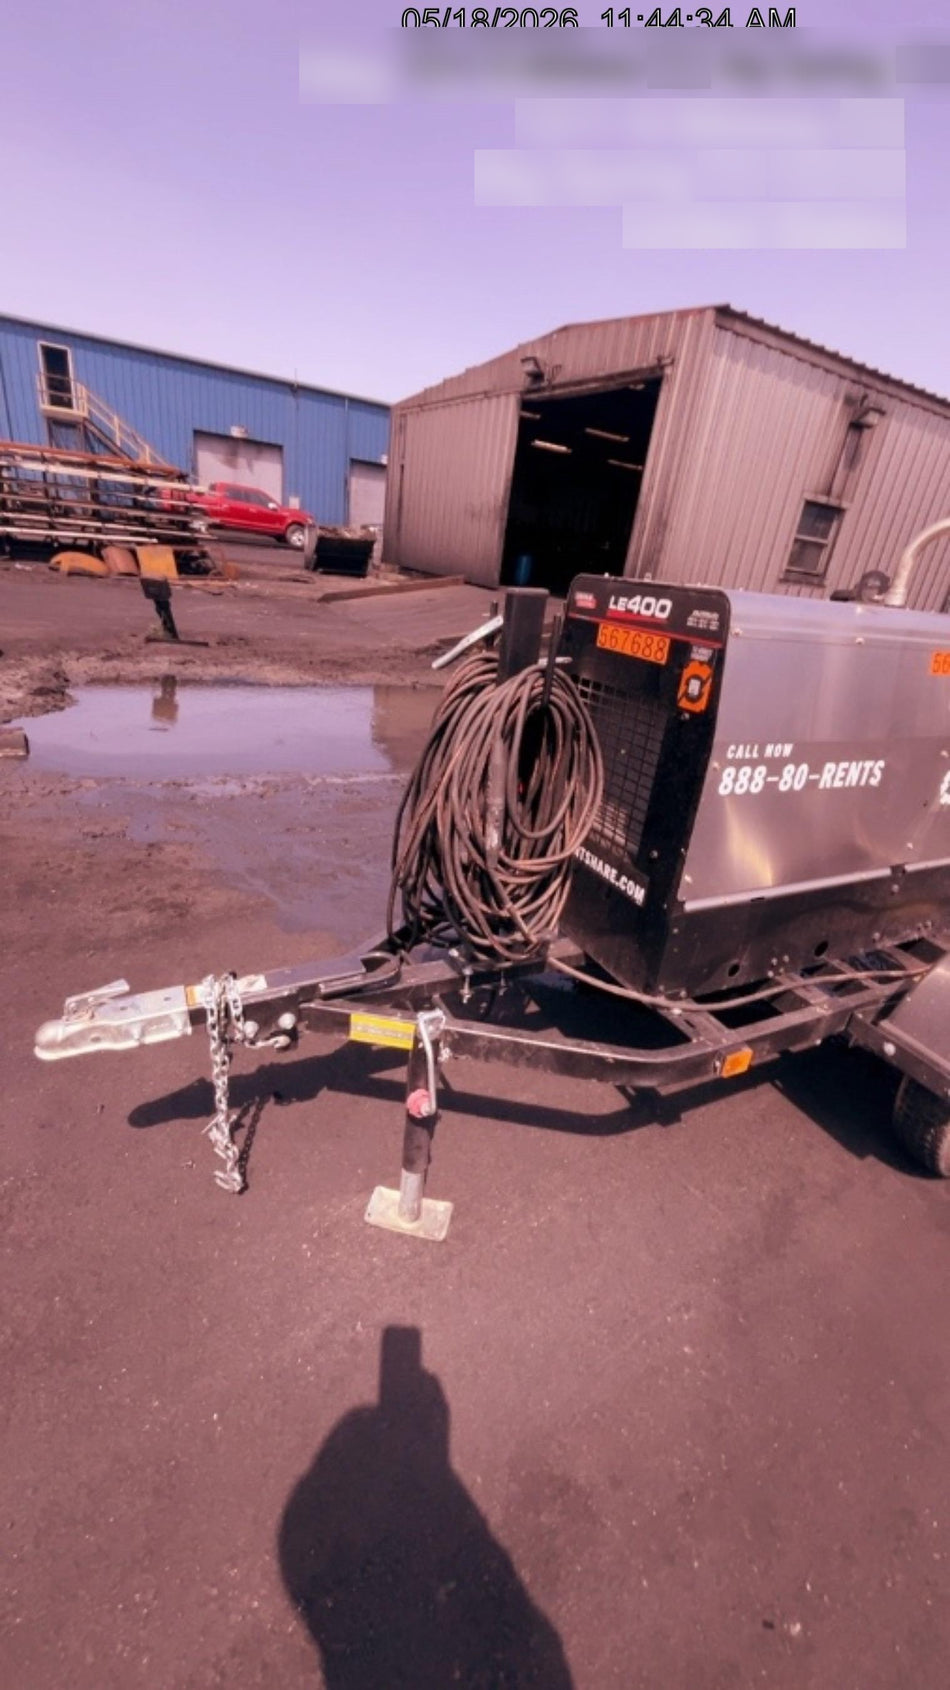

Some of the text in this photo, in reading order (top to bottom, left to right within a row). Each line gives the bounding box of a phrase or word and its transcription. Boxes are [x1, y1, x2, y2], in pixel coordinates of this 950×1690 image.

[608, 594, 673, 619] LE400
[598, 626, 668, 662] 567688
[726, 743, 794, 759] CALL NOW
[718, 760, 885, 796] 888-80-RENTS
